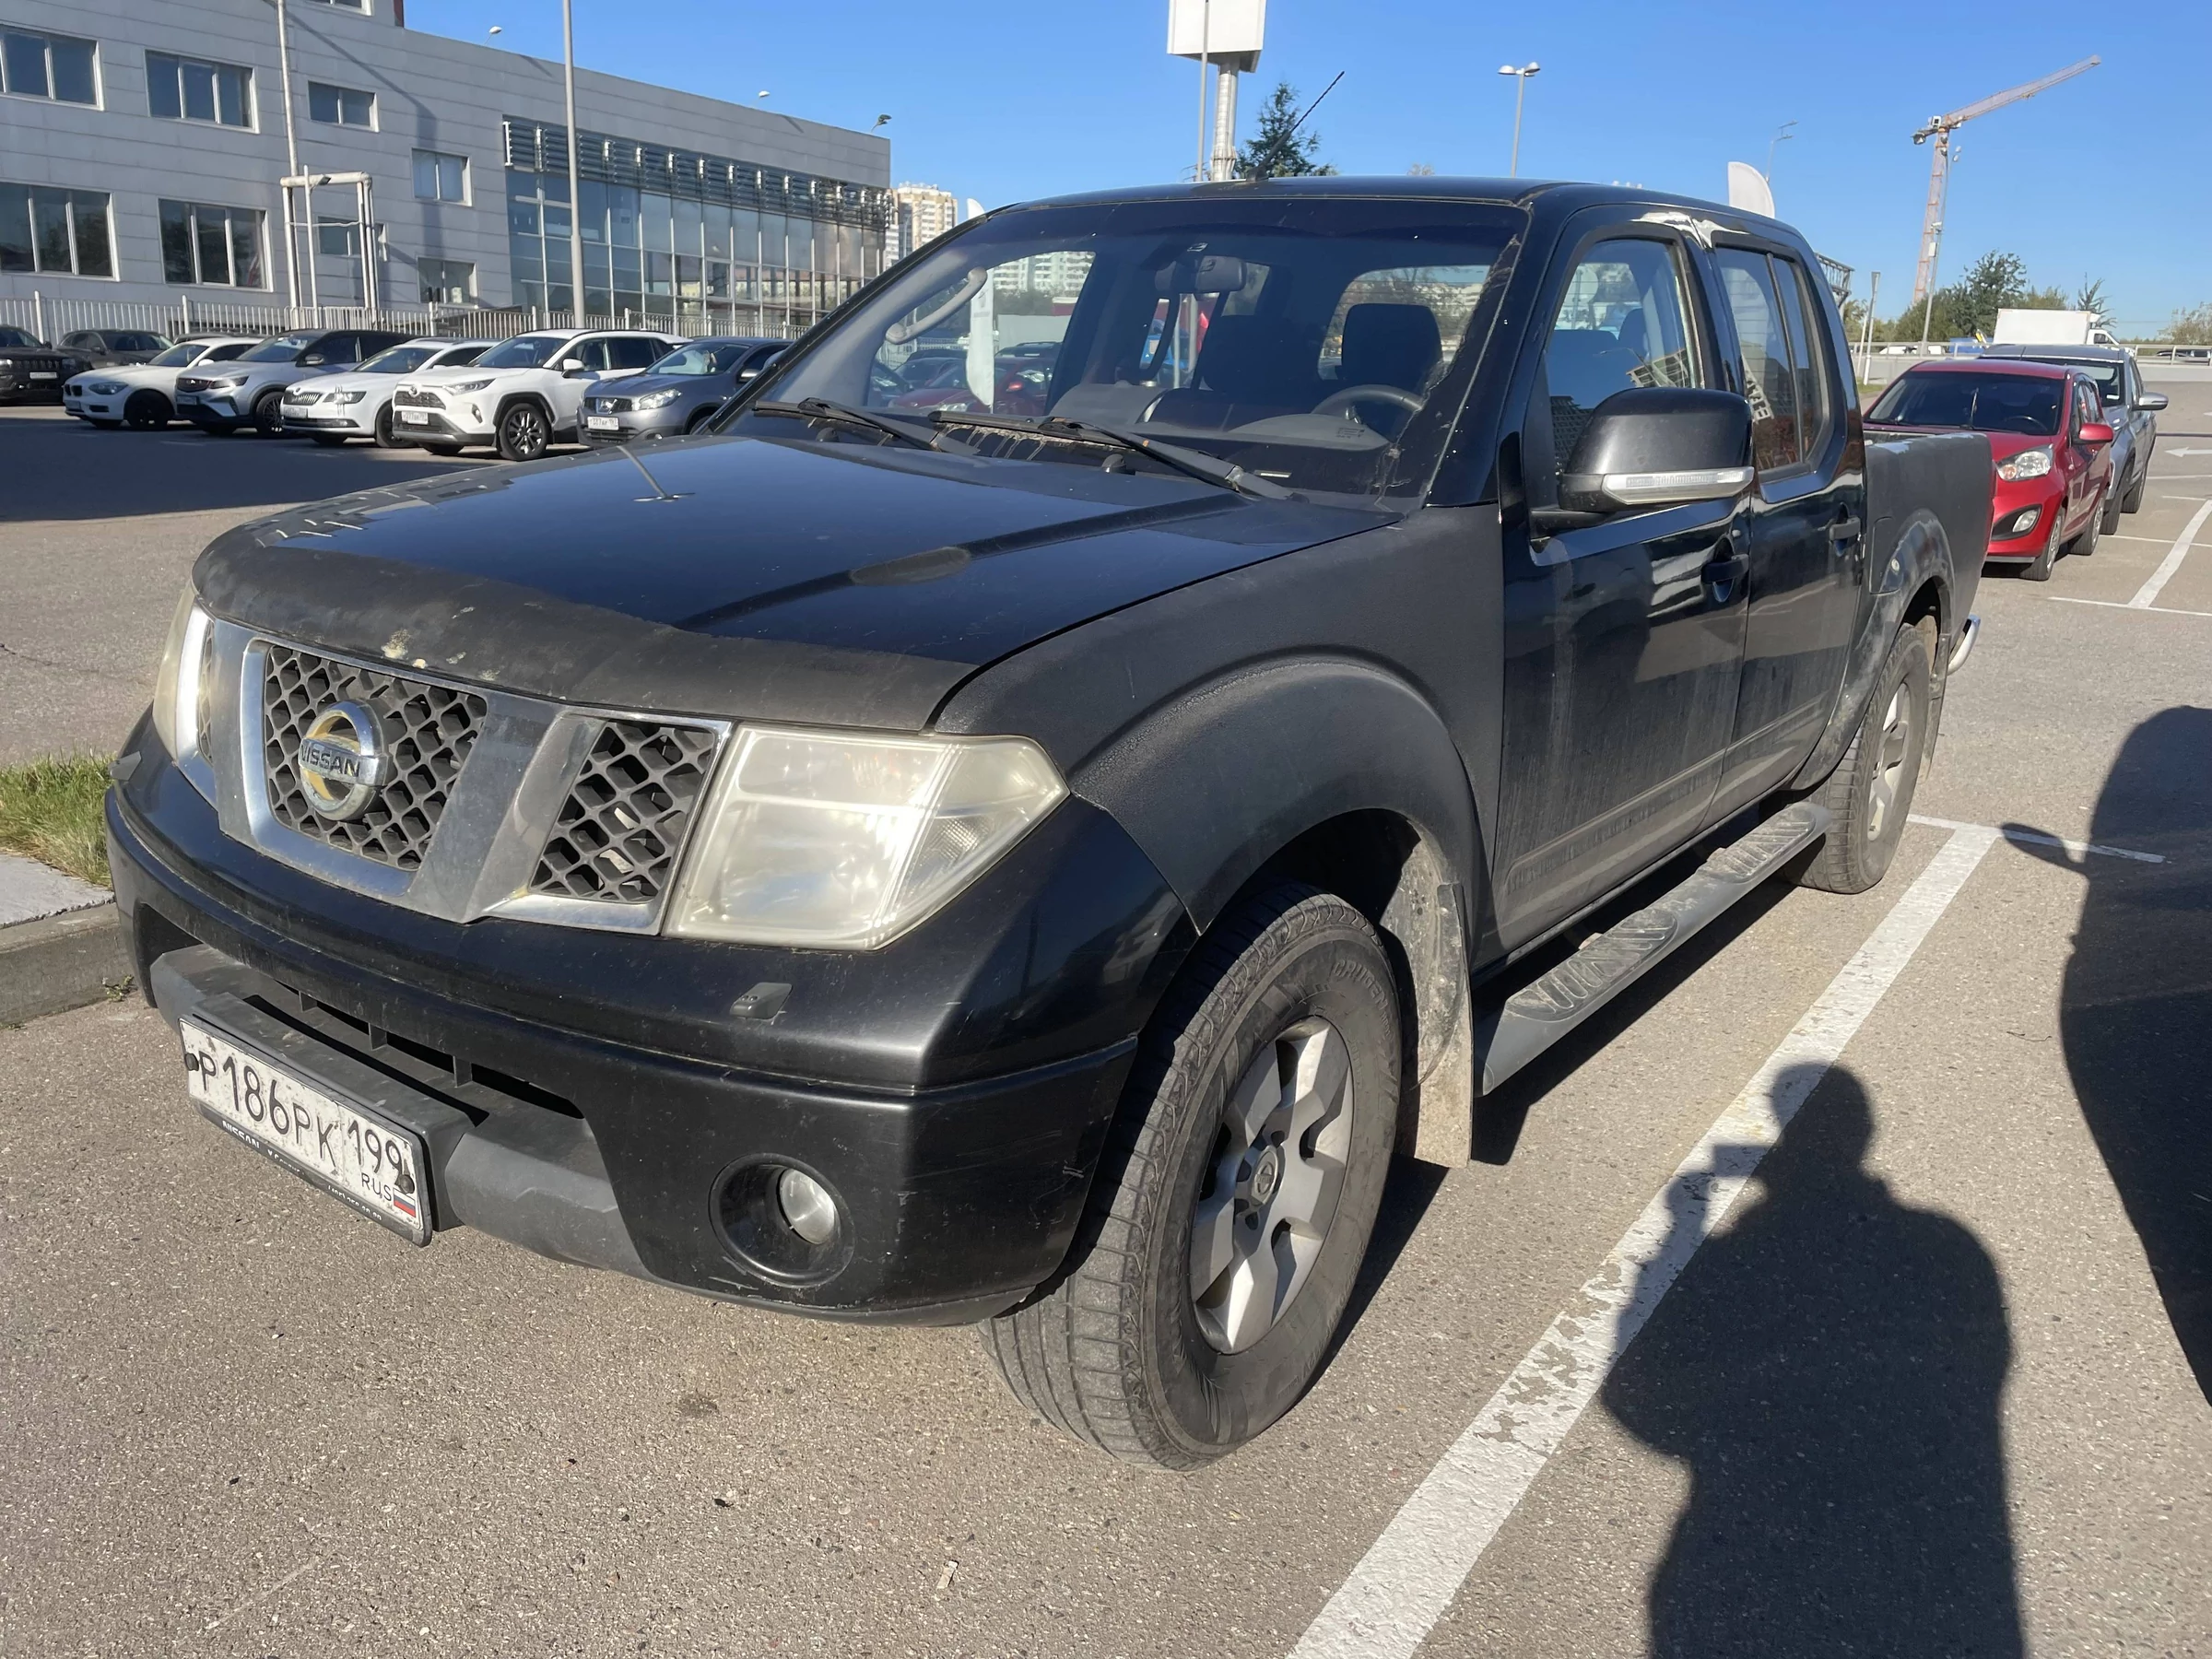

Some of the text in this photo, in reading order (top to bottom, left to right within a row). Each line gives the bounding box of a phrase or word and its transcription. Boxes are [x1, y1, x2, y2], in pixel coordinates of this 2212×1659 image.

[300, 742, 360, 778] NISSAN
[347, 1120, 403, 1174] 199
[360, 1171, 393, 1202] RUS
